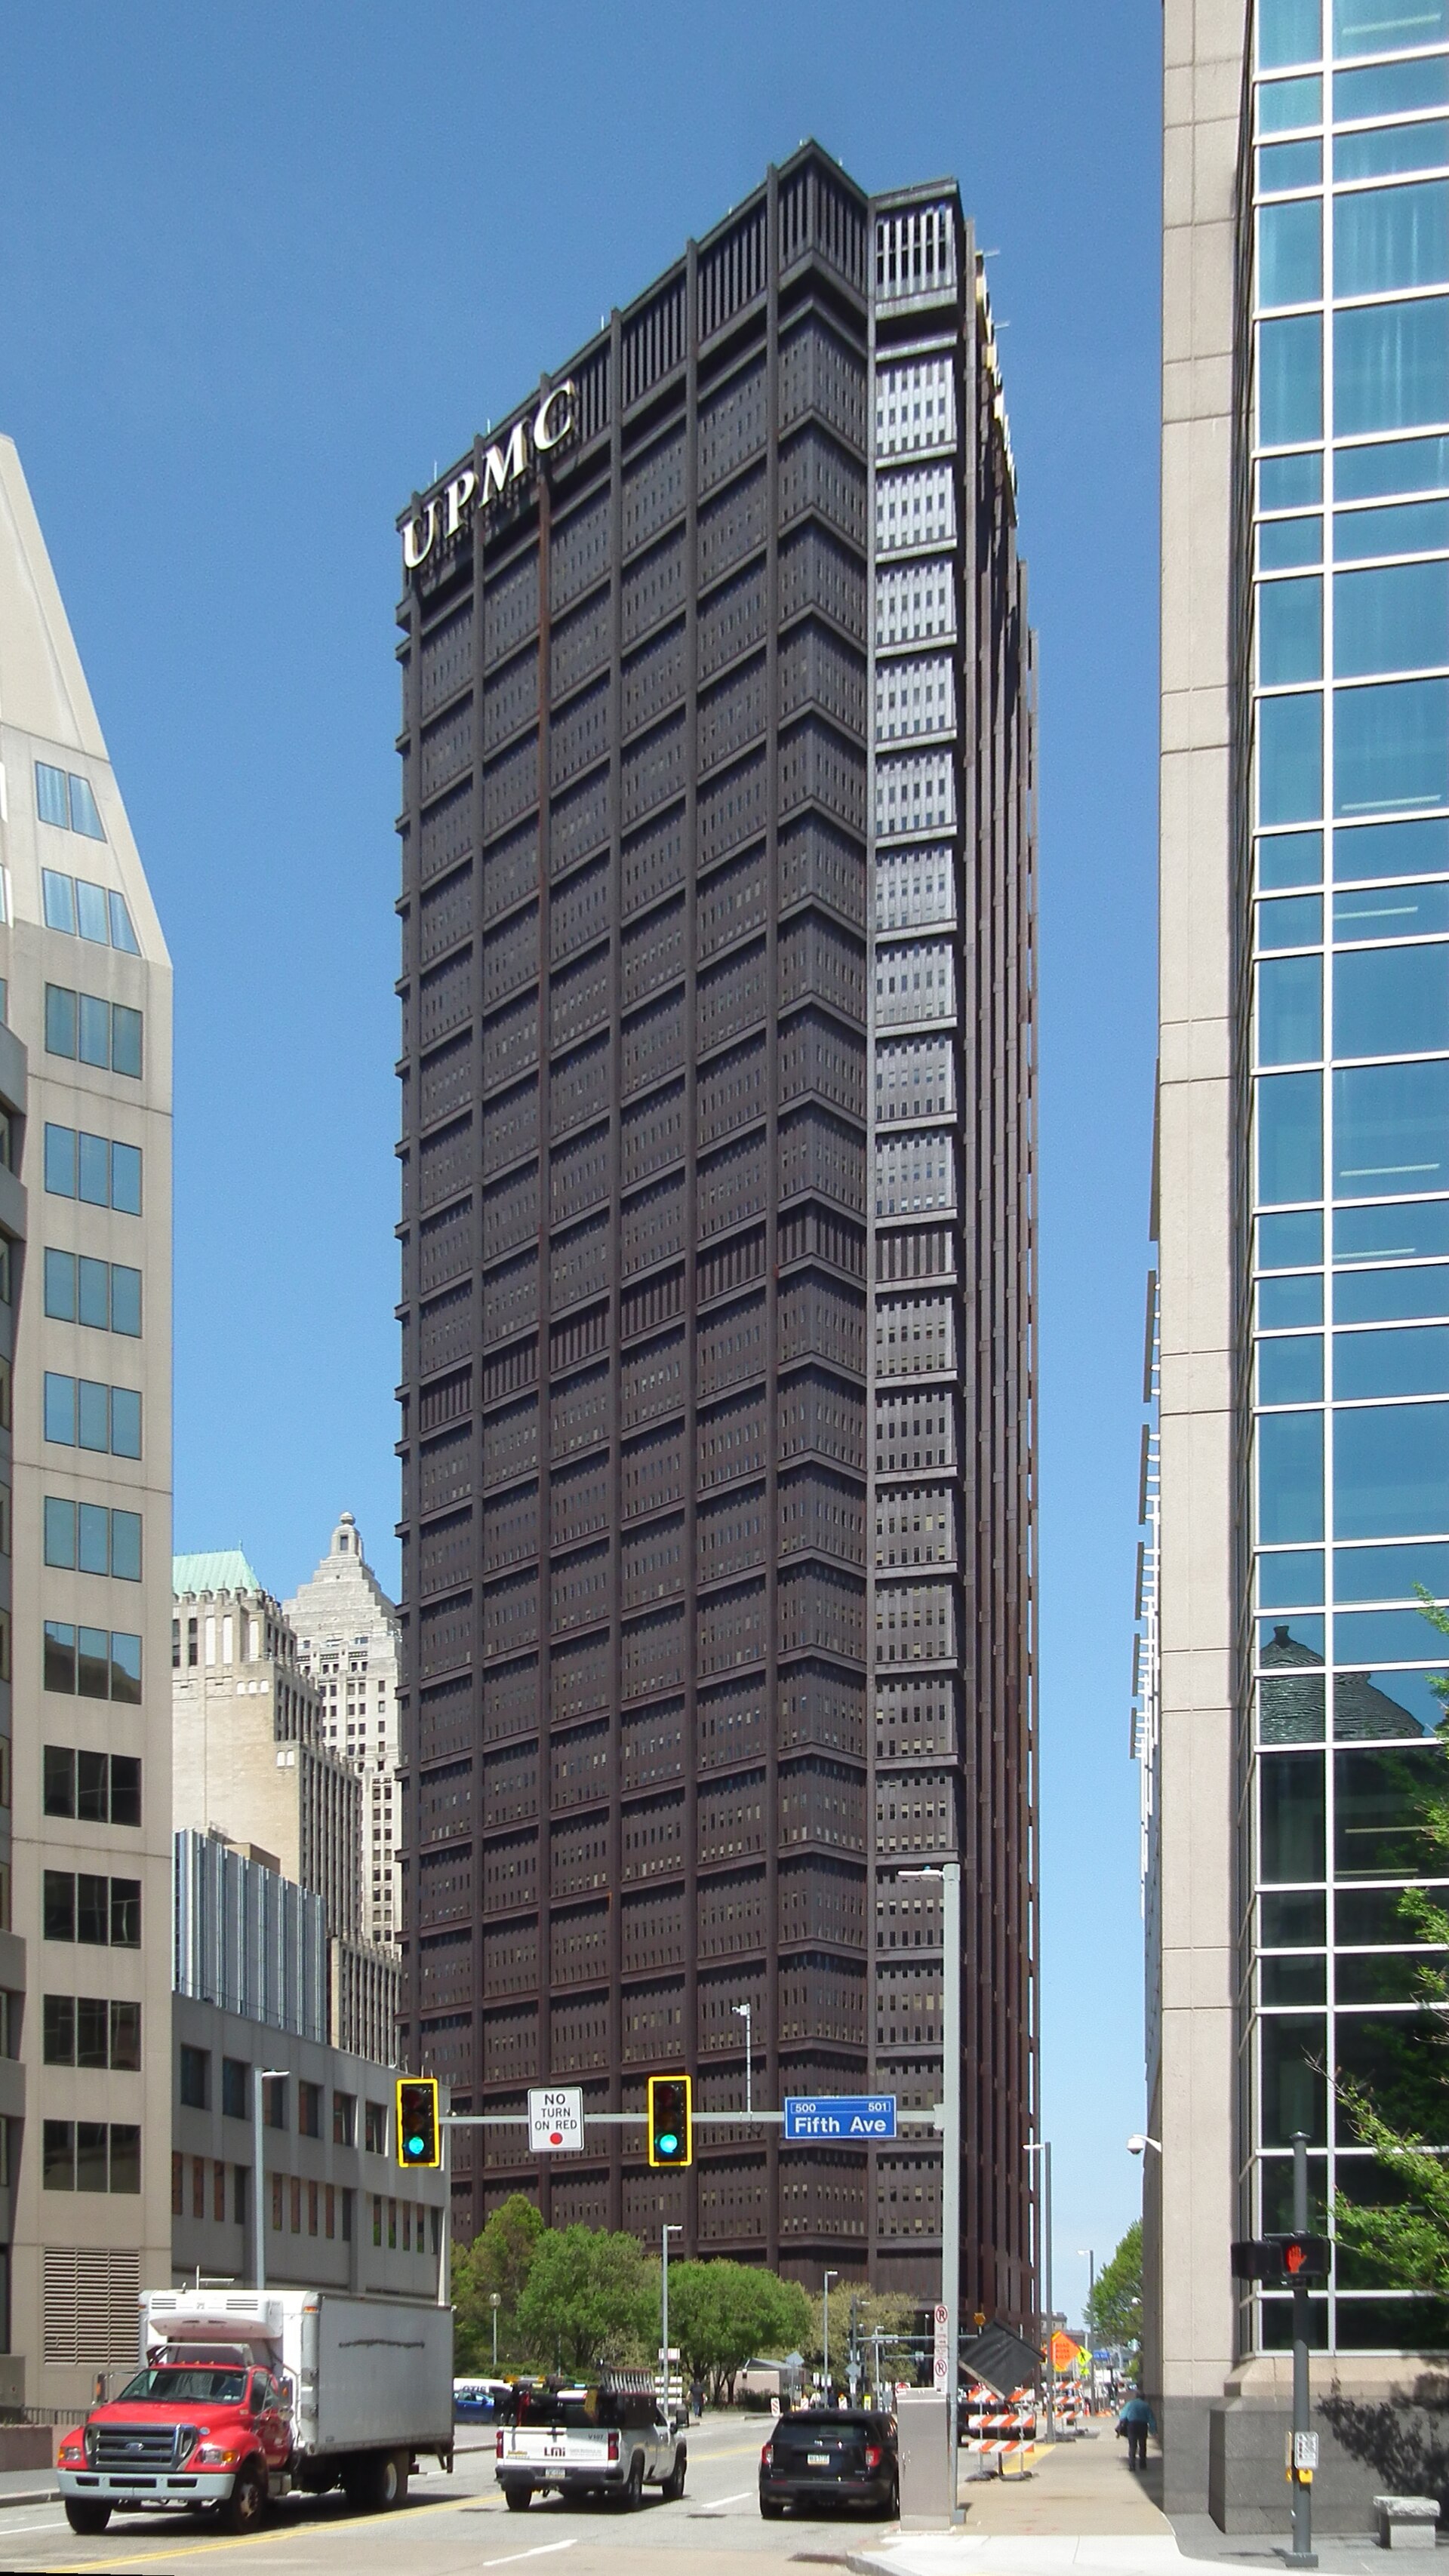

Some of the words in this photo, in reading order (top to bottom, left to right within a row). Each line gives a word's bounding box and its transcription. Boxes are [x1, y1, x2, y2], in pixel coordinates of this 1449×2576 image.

[401, 378, 575, 568] UPMC
[544, 2093, 566, 2105] NO
[541, 2107, 571, 2118] TURN
[795, 2103, 817, 2113] 500
[868, 2101, 887, 2111] 501
[534, 2120, 550, 2131] ON
[555, 2119, 577, 2130] RED
[795, 2116, 840, 2133] Fifth
[850, 2116, 887, 2132] Ave
